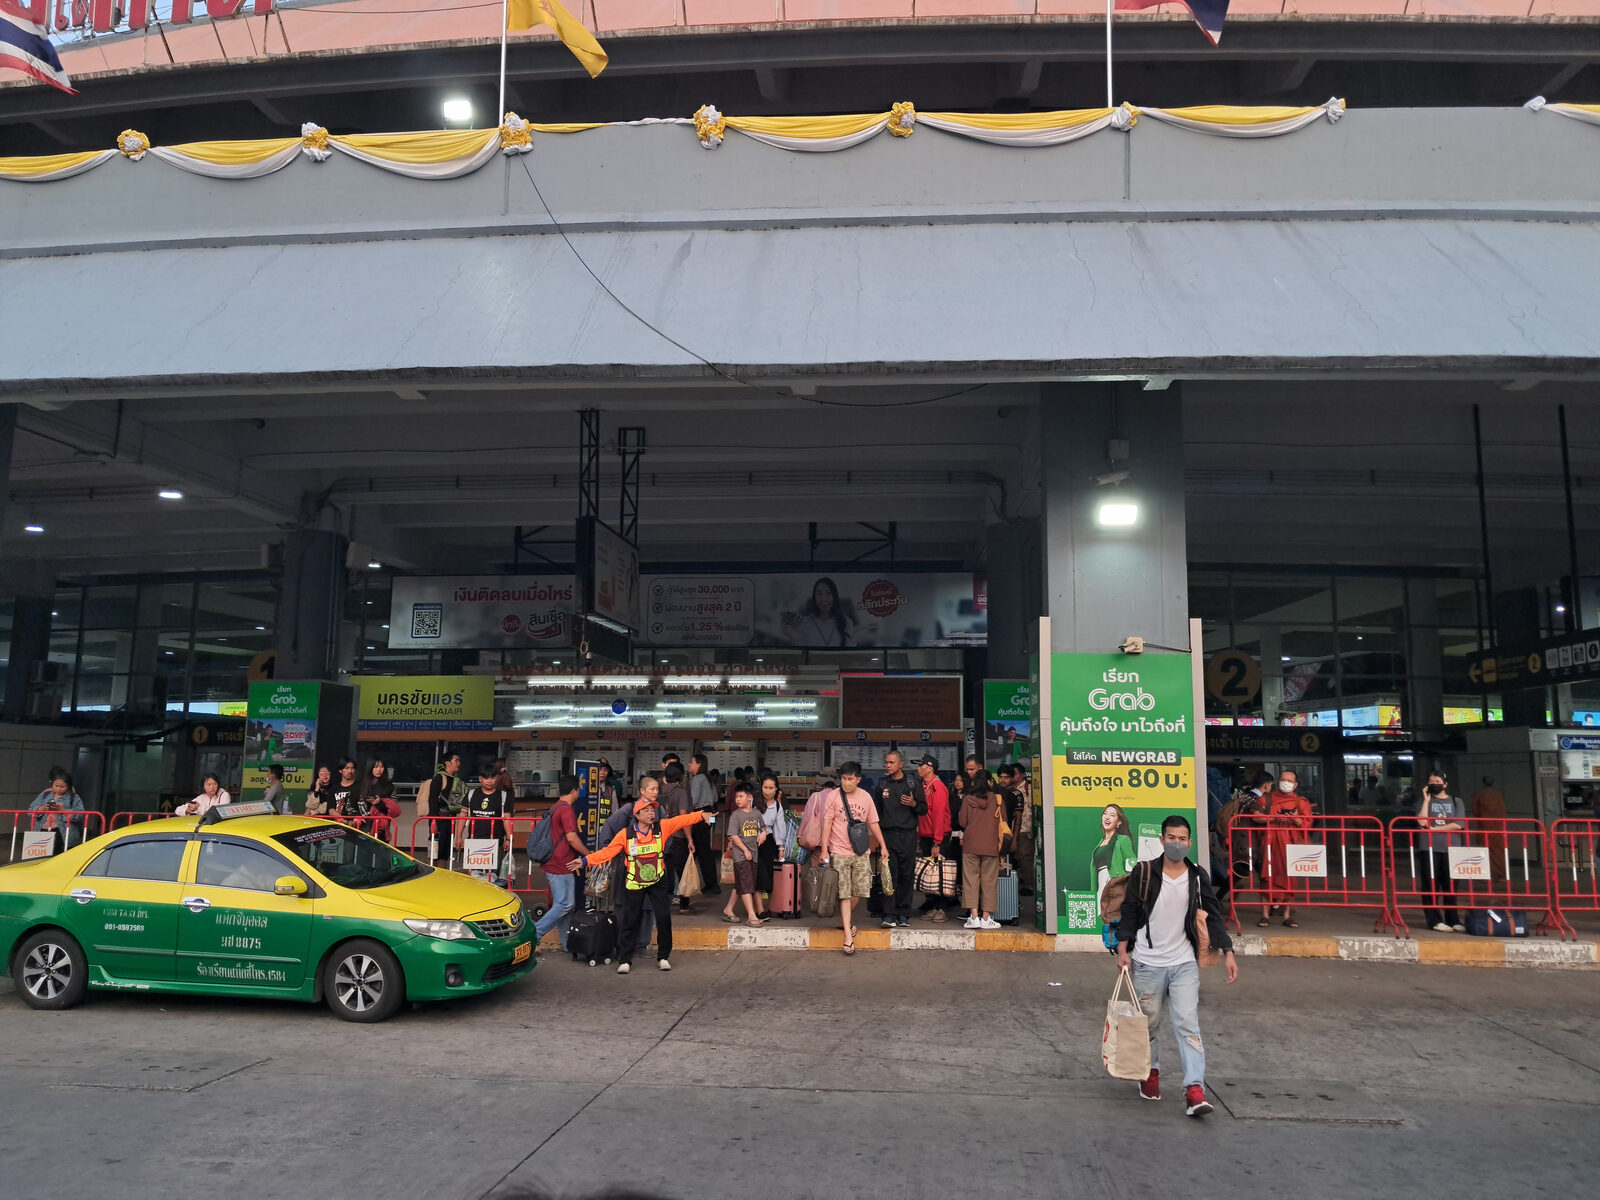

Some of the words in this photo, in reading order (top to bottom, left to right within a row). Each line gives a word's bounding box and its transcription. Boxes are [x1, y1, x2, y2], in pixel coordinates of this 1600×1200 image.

[454, 581, 572, 602] เงินติดลบเมื่อไหร่
[697, 585, 729, 595] 30,000
[697, 603, 723, 614] สูงสุด
[725, 603, 732, 612] 2
[734, 602, 742, 612] ปี
[529, 607, 566, 626] สินเชื่อ
[690, 622, 712, 632] 1.25
[1103, 668, 1140, 684] เรียก
[1221, 658, 1248, 696] 2
[276, 685, 291, 693] เรียก
[270, 694, 296, 705] Grab
[377, 688, 465, 706] นครชัยแอร์
[1088, 686, 1156, 711] Grab
[377, 708, 463, 716] NAKHONCHAIAIR
[1060, 717, 1118, 736] คุ้มถึงใจ
[1122, 715, 1186, 733] มาไวถึงที่
[857, 732, 866, 740] 28
[921, 732, 930, 740] 29
[1242, 736, 1290, 749] Entrance
[1072, 751, 1097, 761] ใส่โค้ด
[1101, 751, 1177, 764] NEWGRAB
[1061, 775, 1124, 792] ลดสูงสุด
[1127, 768, 1160, 789] 80
[469, 857, 491, 865] บขส
[1295, 864, 1319, 873] บขส
[1457, 866, 1482, 875] บขส
[235, 936, 261, 949] 8875
